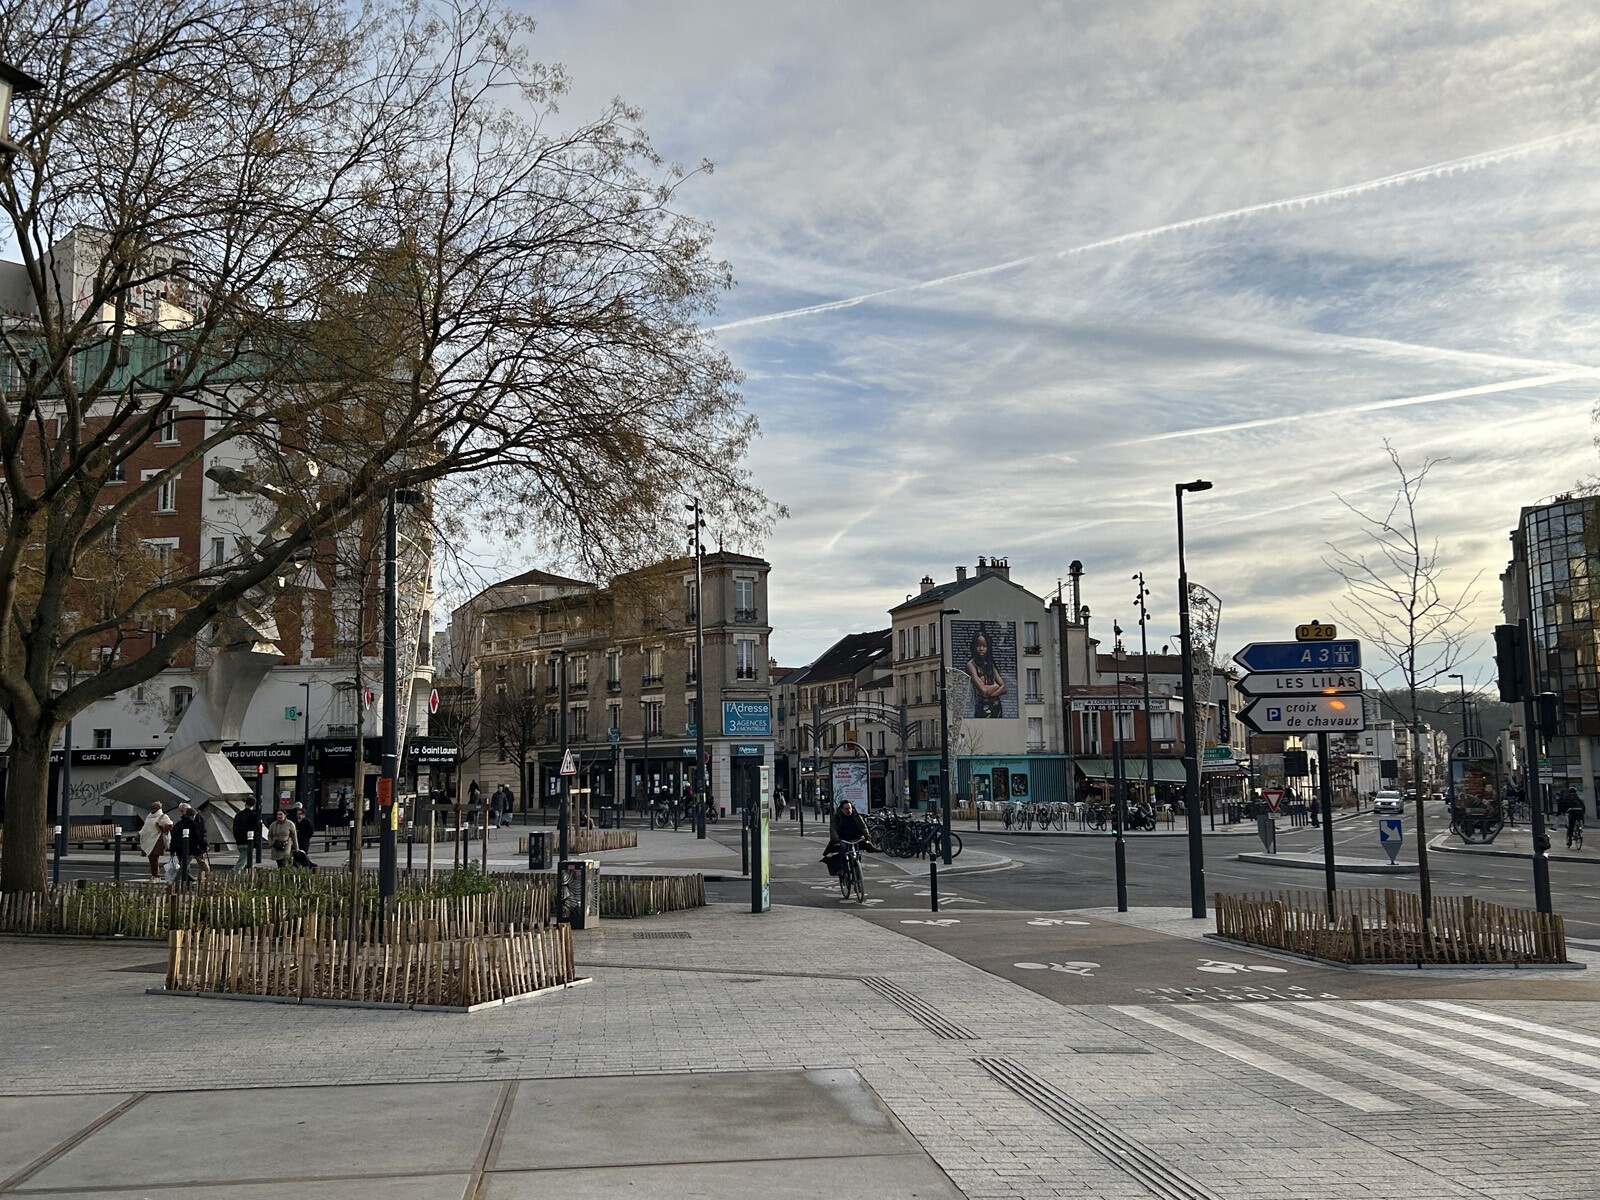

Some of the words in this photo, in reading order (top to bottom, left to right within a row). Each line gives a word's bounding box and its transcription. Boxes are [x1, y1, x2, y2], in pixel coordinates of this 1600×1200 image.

[1301, 627, 1309, 637] D
[1314, 627, 1333, 637] 20
[1301, 649, 1312, 662] A
[1318, 649, 1329, 661] 3
[1276, 678, 1304, 688] LES
[1312, 676, 1356, 688] LILAS
[726, 702, 769, 717] l'Adresse
[1286, 702, 1317, 712] croix
[729, 720, 736, 731] 3
[1287, 716, 1302, 727] de
[1307, 716, 1360, 727] chavaux
[240, 749, 267, 758] D'UTILITÉ
[410, 746, 420, 754] Le
[422, 746, 440, 754] Saint
